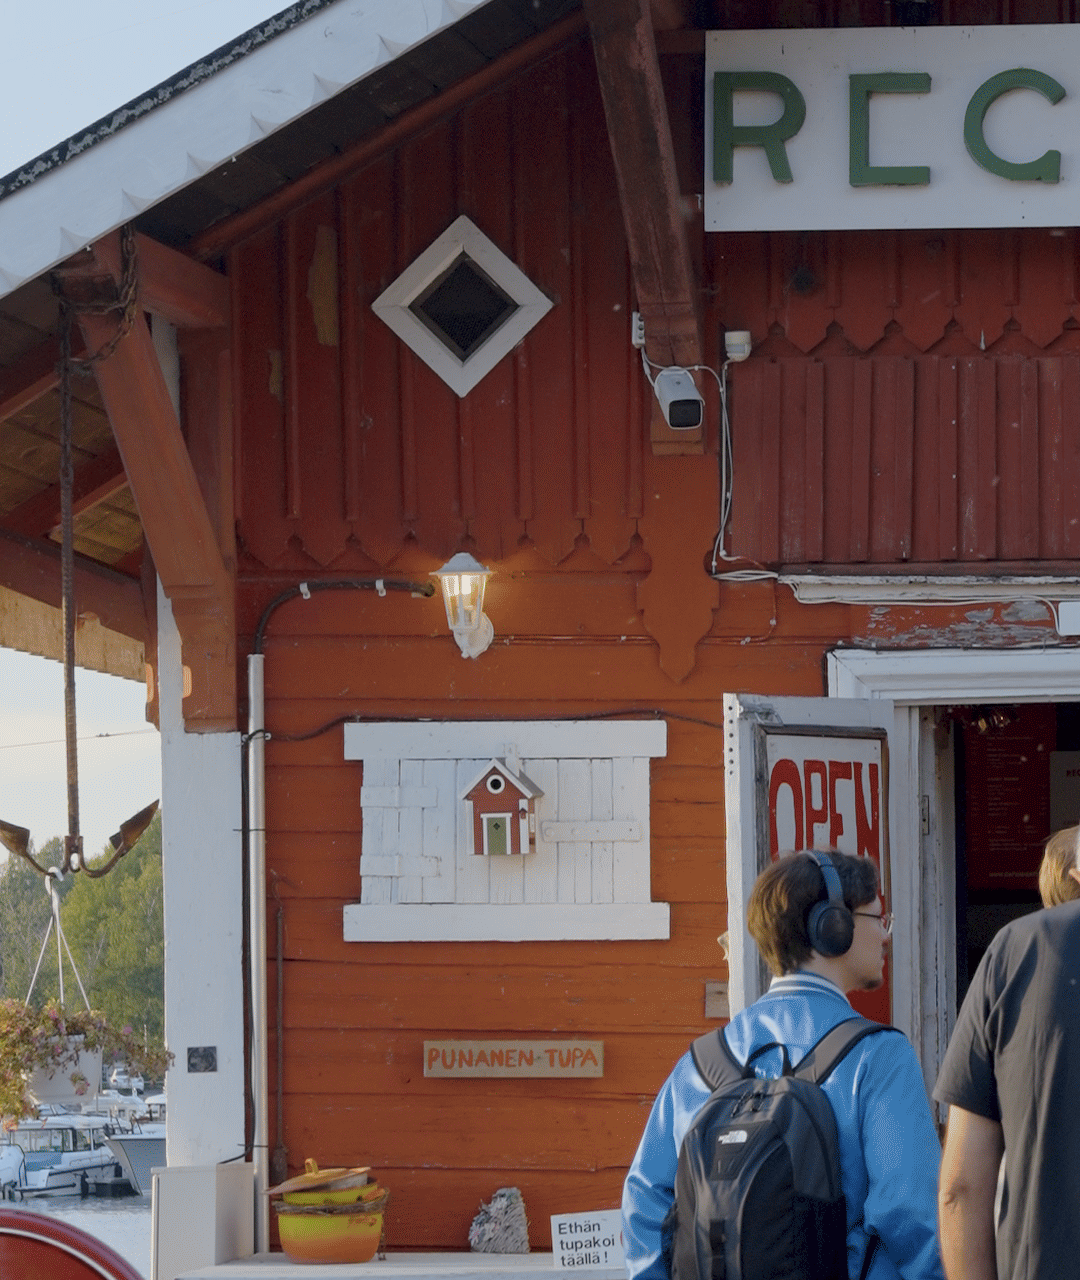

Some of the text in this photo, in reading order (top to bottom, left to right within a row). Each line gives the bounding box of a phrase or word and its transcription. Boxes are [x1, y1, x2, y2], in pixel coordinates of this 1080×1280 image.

[767, 757, 882, 863] OPEN
[544, 1047, 598, 1069] TUPA
[558, 1220, 601, 1235] Ethän
[560, 1234, 615, 1252] tupakoi
[561, 1251, 600, 1267] täällä
